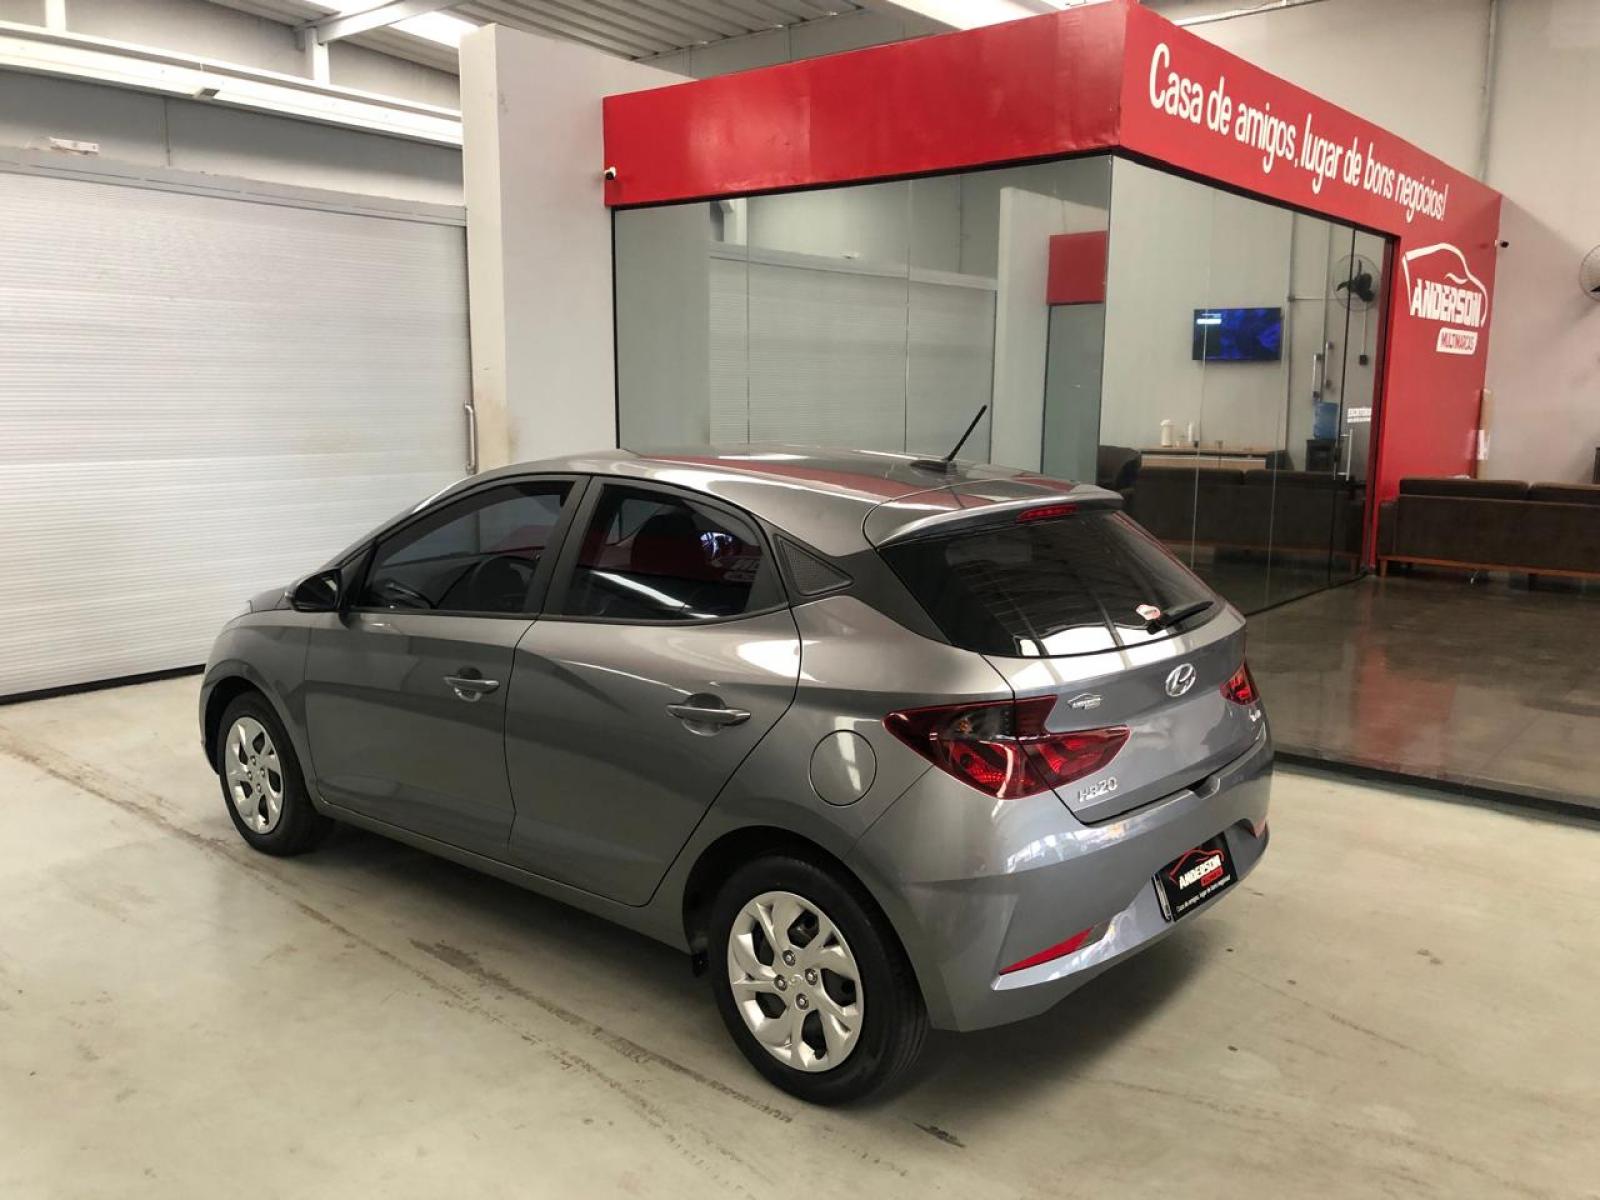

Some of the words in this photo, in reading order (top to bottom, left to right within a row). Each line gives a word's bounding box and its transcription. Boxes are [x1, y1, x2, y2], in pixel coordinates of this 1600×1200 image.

[1150, 43, 1203, 125] Casa
[1206, 76, 1232, 135] de
[1235, 102, 1299, 174] amigos,
[1300, 113, 1343, 194] lugar
[1343, 136, 1362, 187] de
[1363, 142, 1395, 201] bons
[1395, 171, 1448, 223] negócios!
[1410, 278, 1483, 328] ANDERSON
[1078, 776, 1118, 802] HB20
[1179, 854, 1222, 890] ANDERSON
